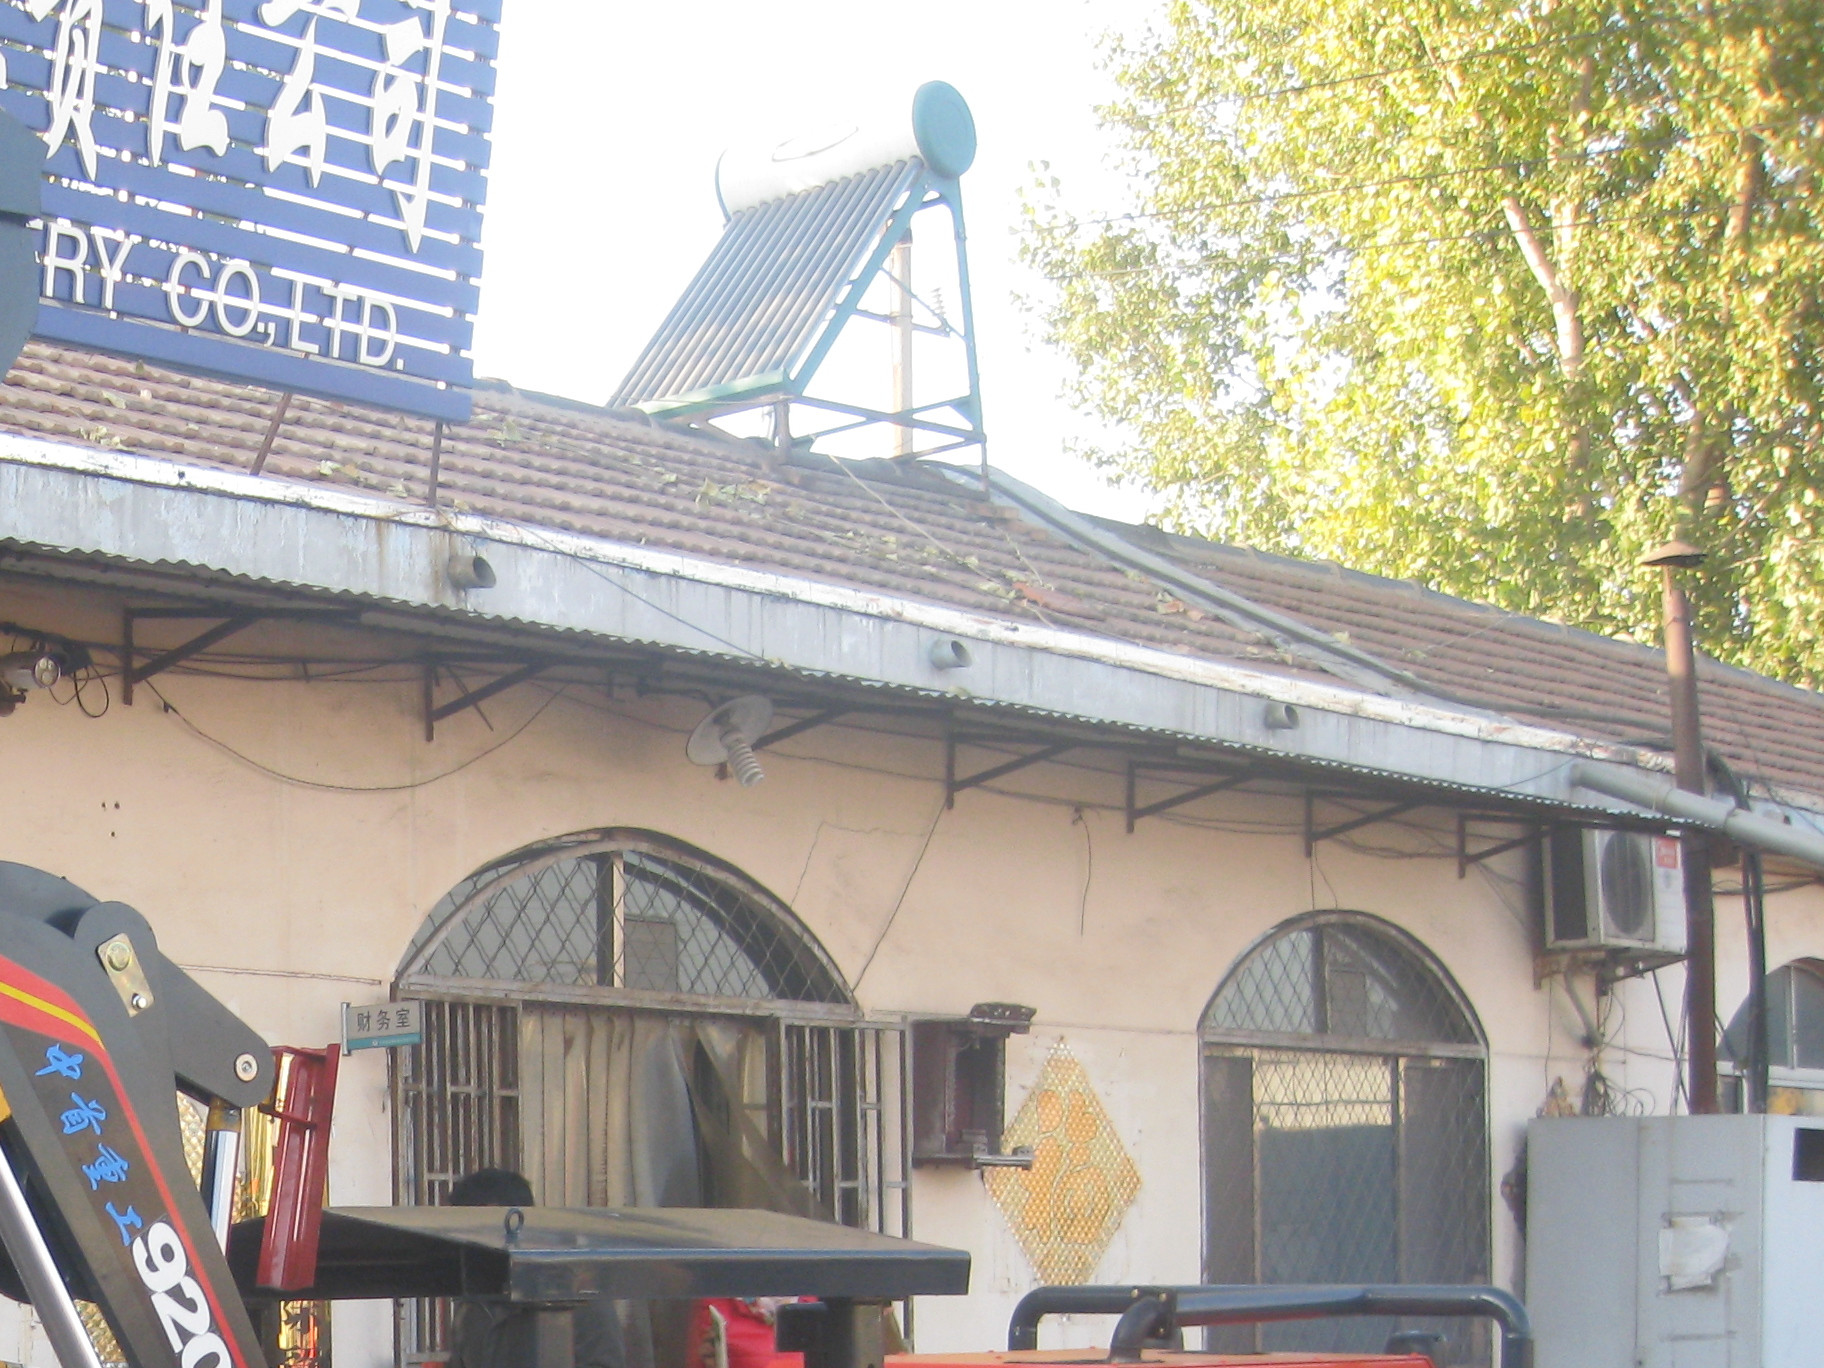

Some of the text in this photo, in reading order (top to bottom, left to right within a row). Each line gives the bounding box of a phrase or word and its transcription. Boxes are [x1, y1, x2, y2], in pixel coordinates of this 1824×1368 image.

[167, 251, 405, 371] CO.,LTD.
[357, 1008, 410, 1032] 财务室
[35, 1043, 143, 1246] 中首重工
